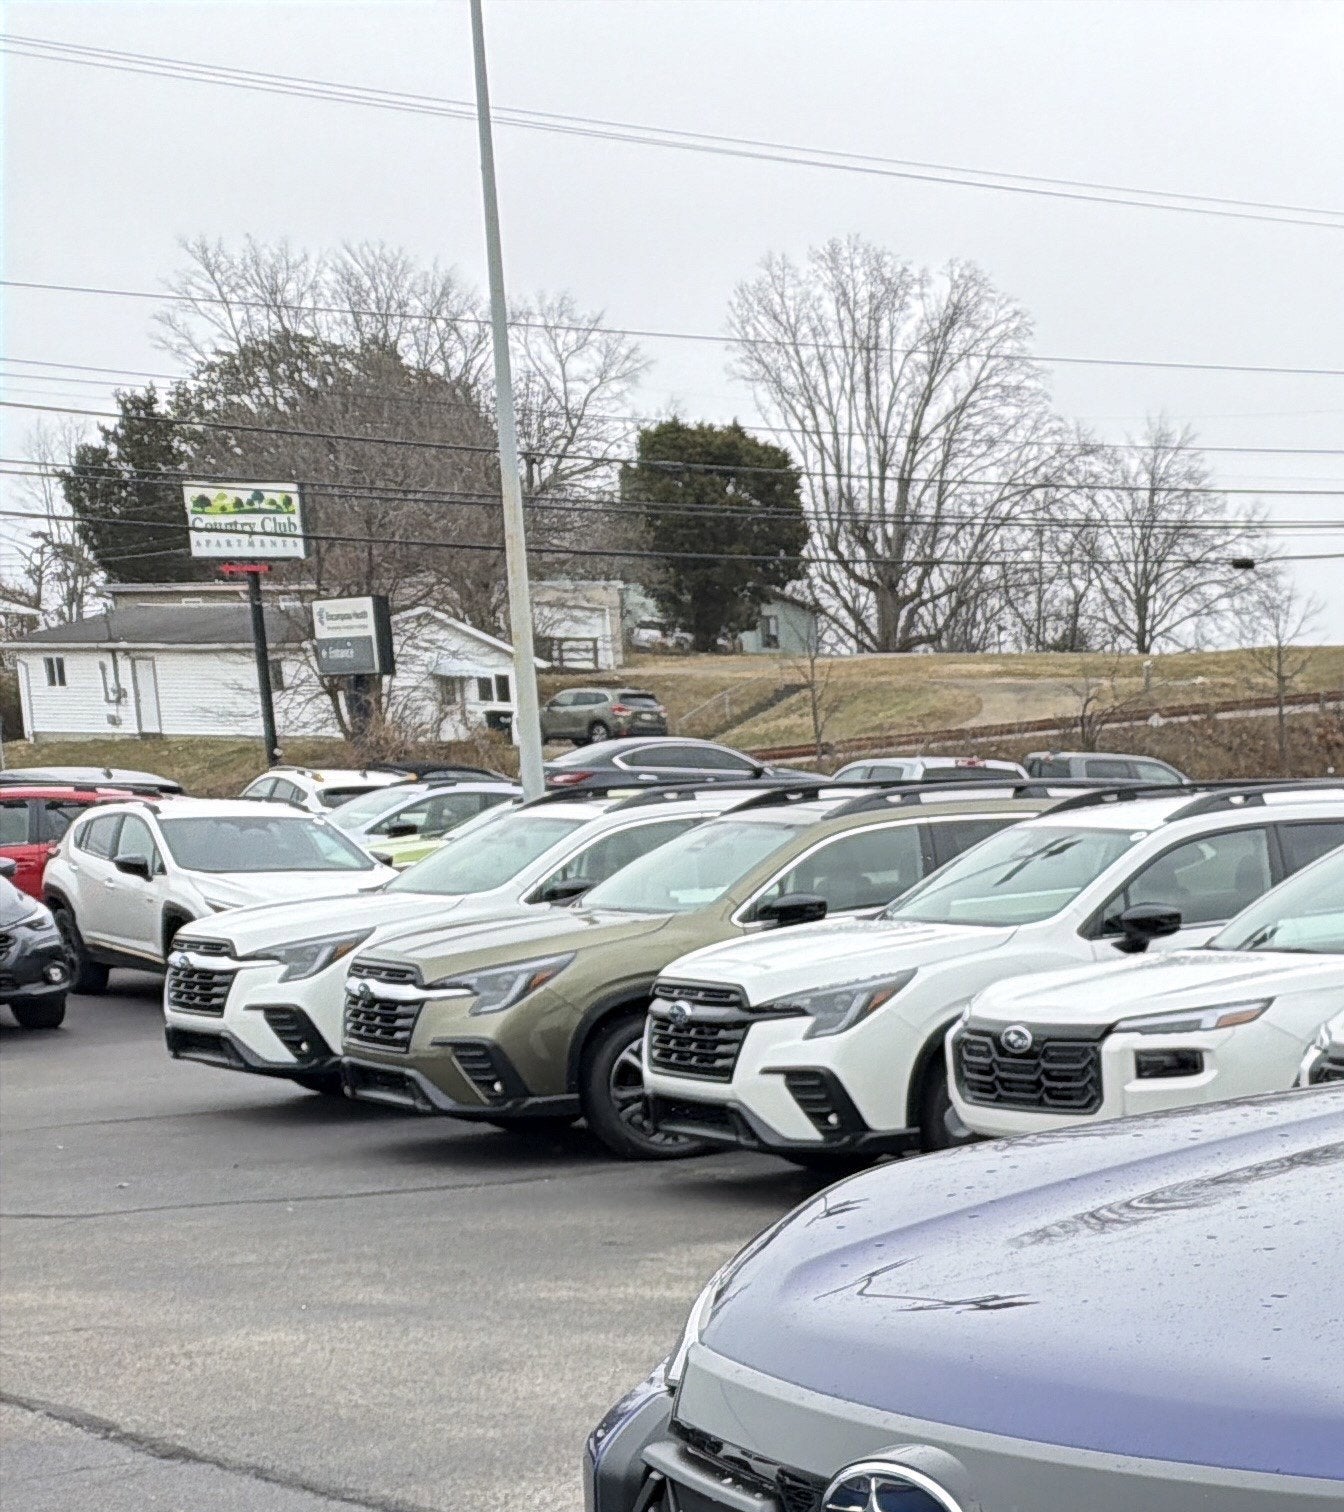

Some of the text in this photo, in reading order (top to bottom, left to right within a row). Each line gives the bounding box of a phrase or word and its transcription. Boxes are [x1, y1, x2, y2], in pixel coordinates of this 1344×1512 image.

[191, 516, 298, 538] Country Club
[195, 539, 298, 549] APARTMENTS
